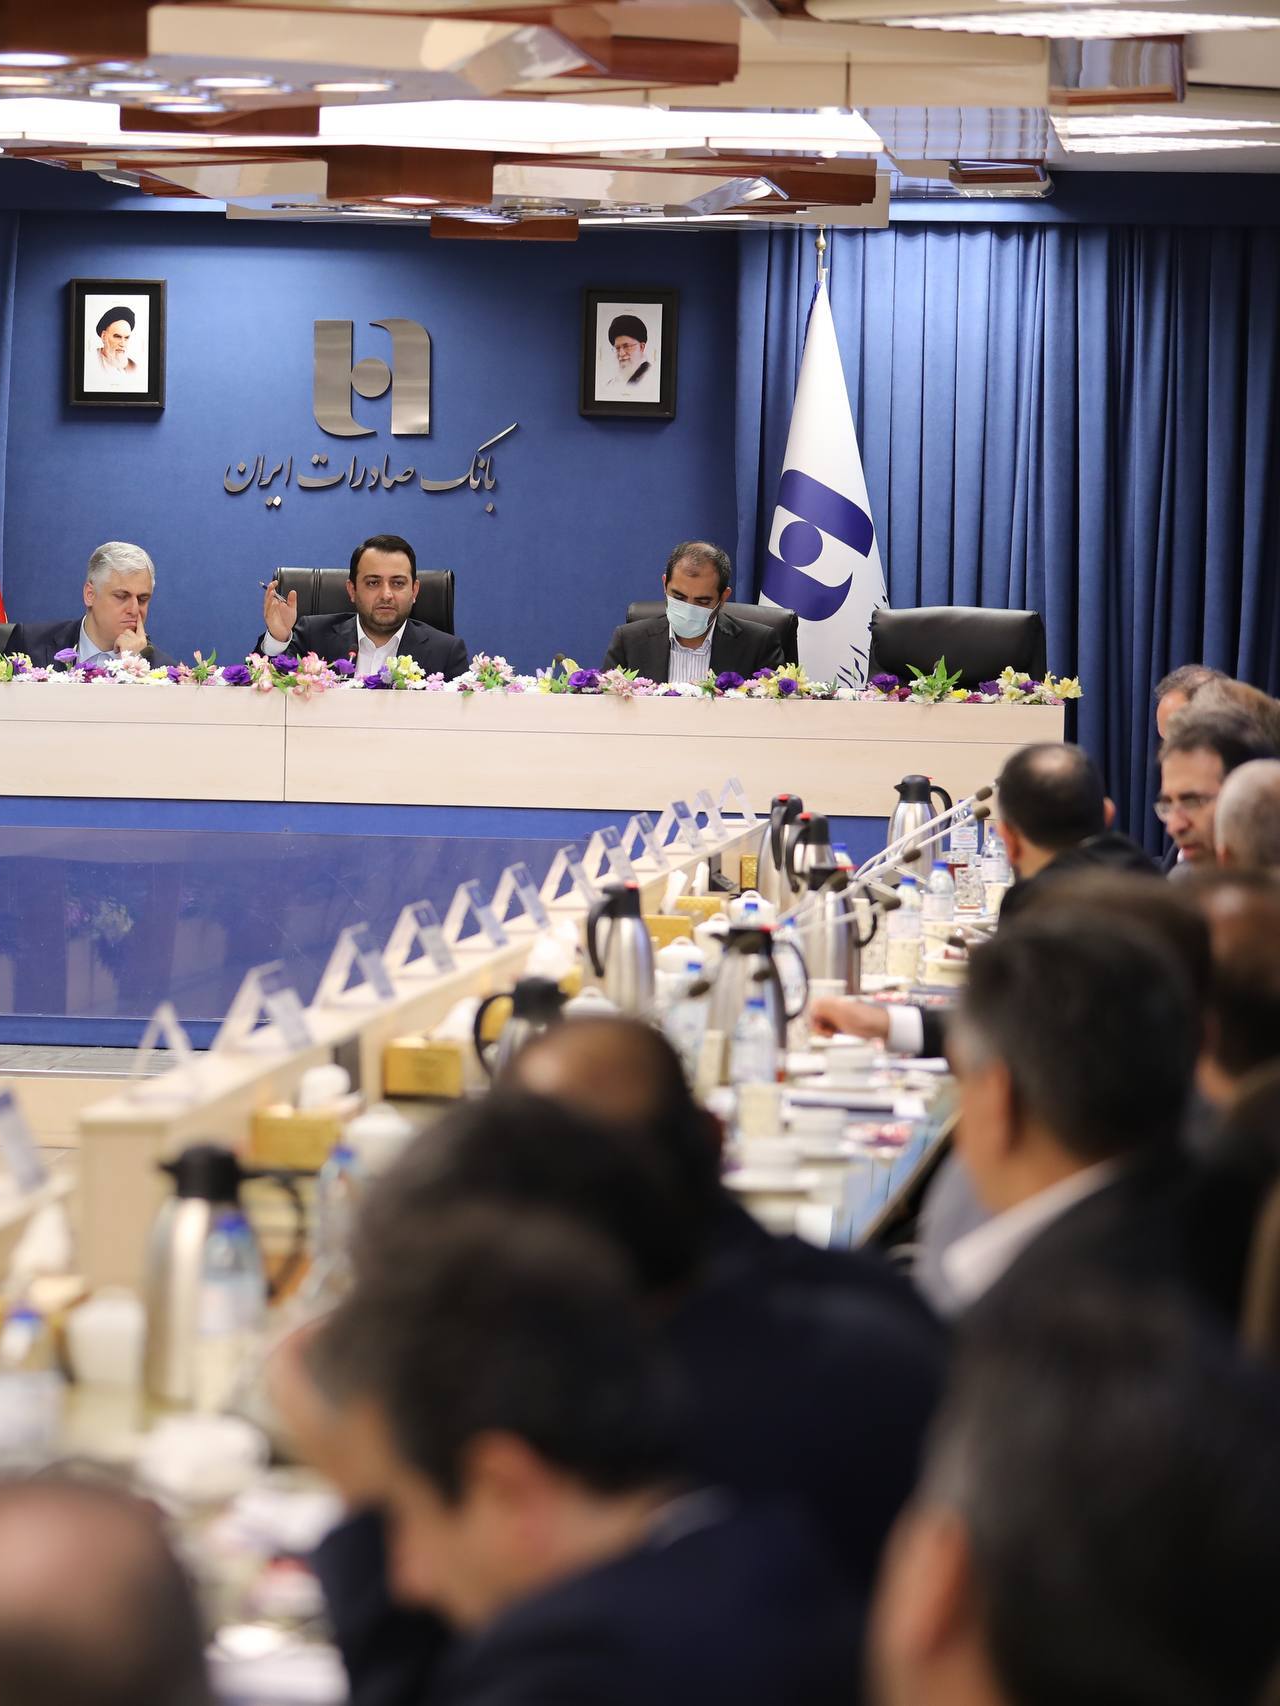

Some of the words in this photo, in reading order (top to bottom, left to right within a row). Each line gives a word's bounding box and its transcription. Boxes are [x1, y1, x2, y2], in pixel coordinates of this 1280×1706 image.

[223, 455, 293, 506] ایران
[296, 453, 416, 489] صادرات
[420, 422, 517, 513] بانک
